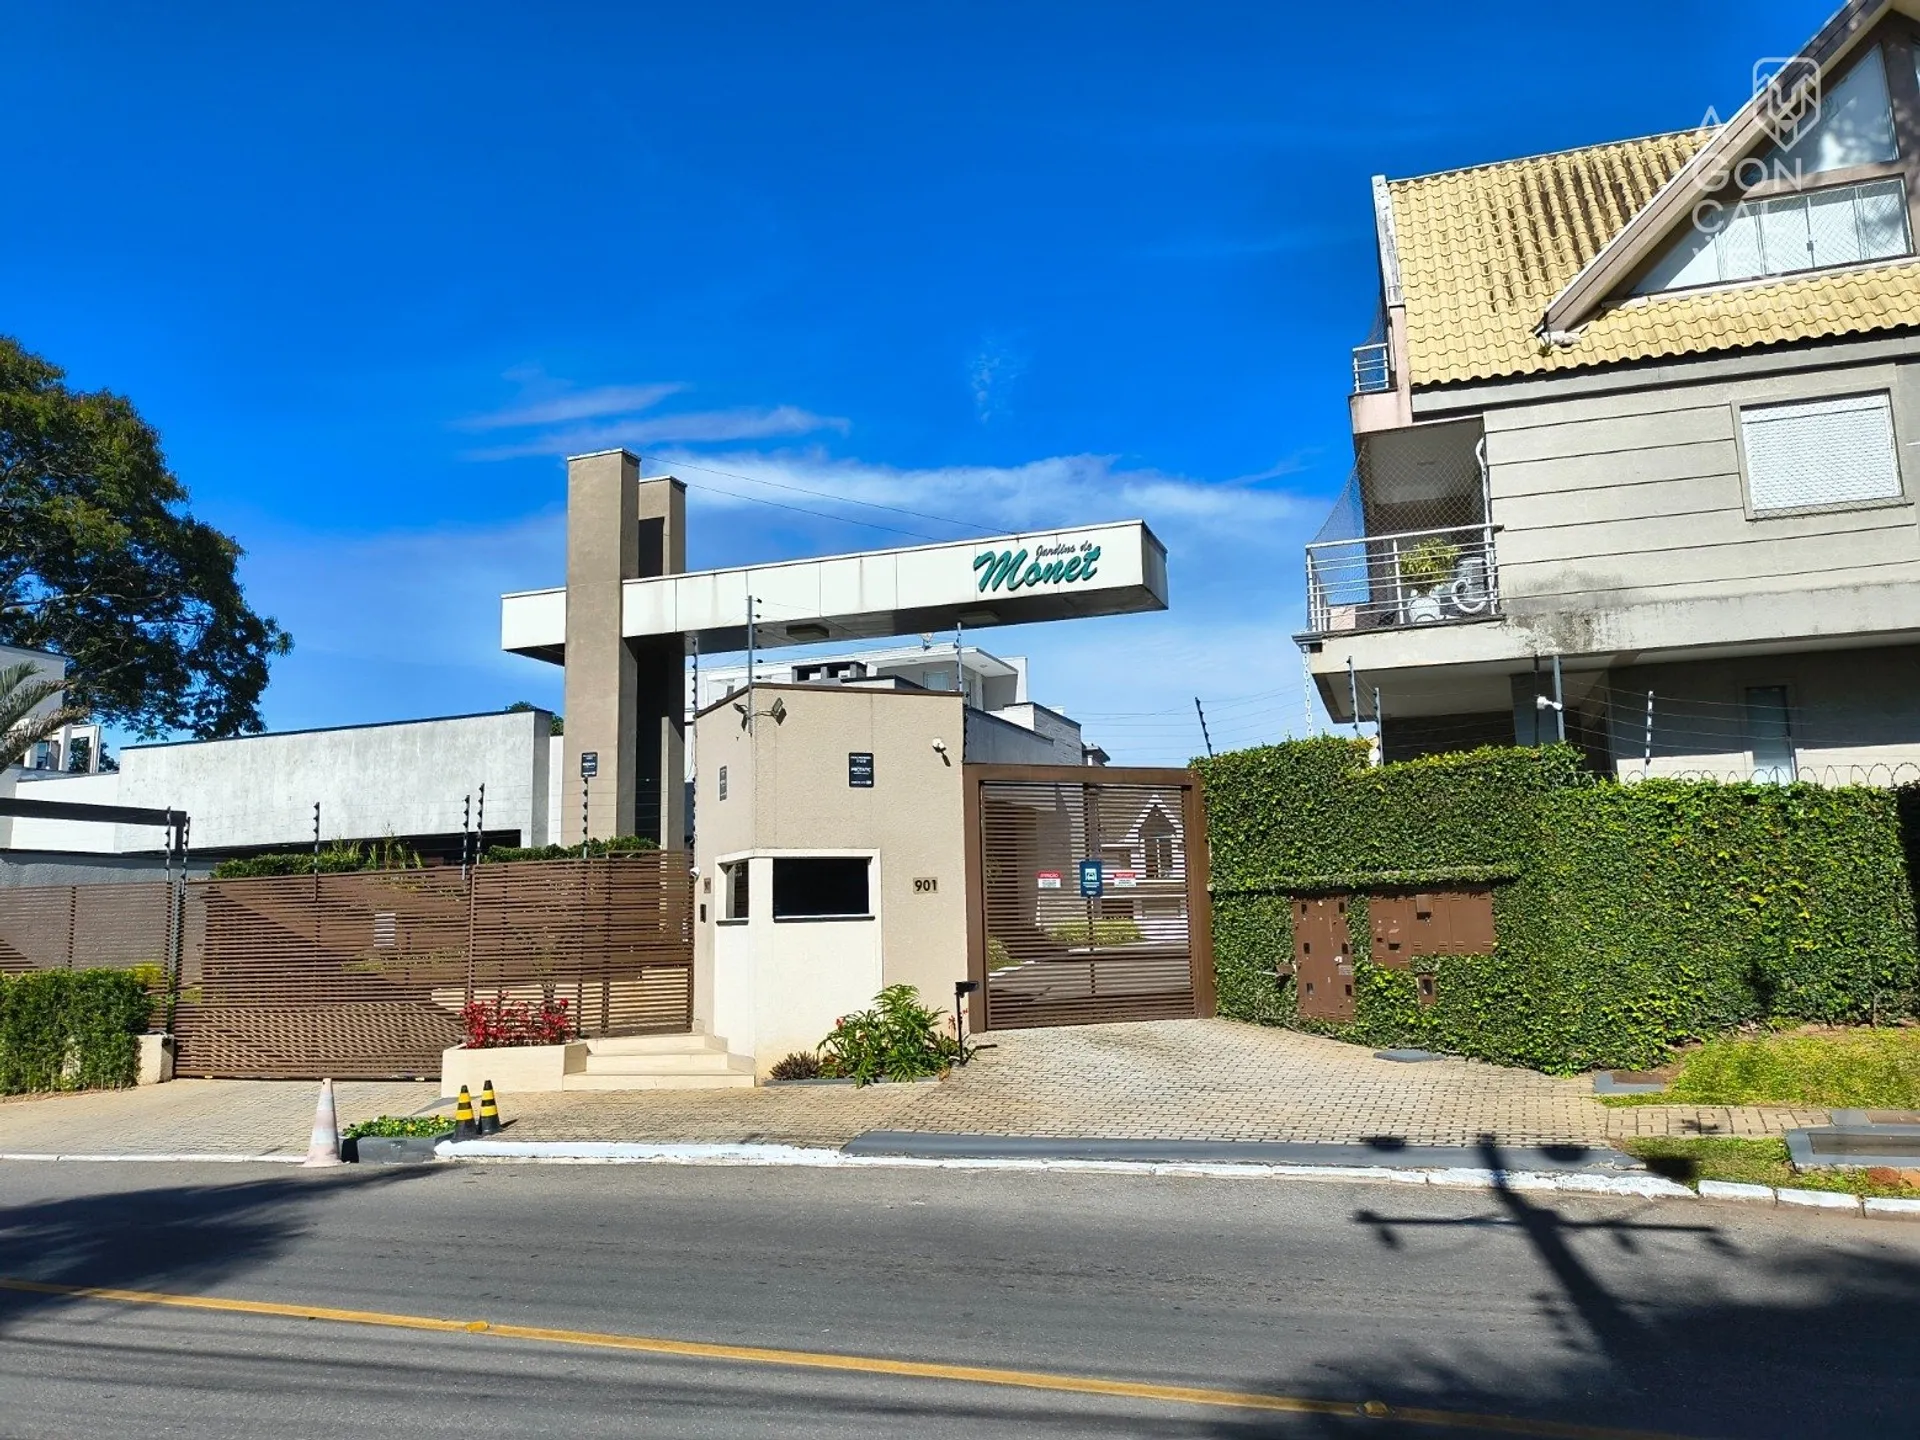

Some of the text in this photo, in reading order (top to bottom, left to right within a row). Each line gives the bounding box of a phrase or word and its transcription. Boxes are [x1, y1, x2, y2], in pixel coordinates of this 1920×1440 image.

[1035, 543, 1076, 561] Jardins
[973, 546, 1101, 593] Monet
[915, 879, 936, 891] 901
